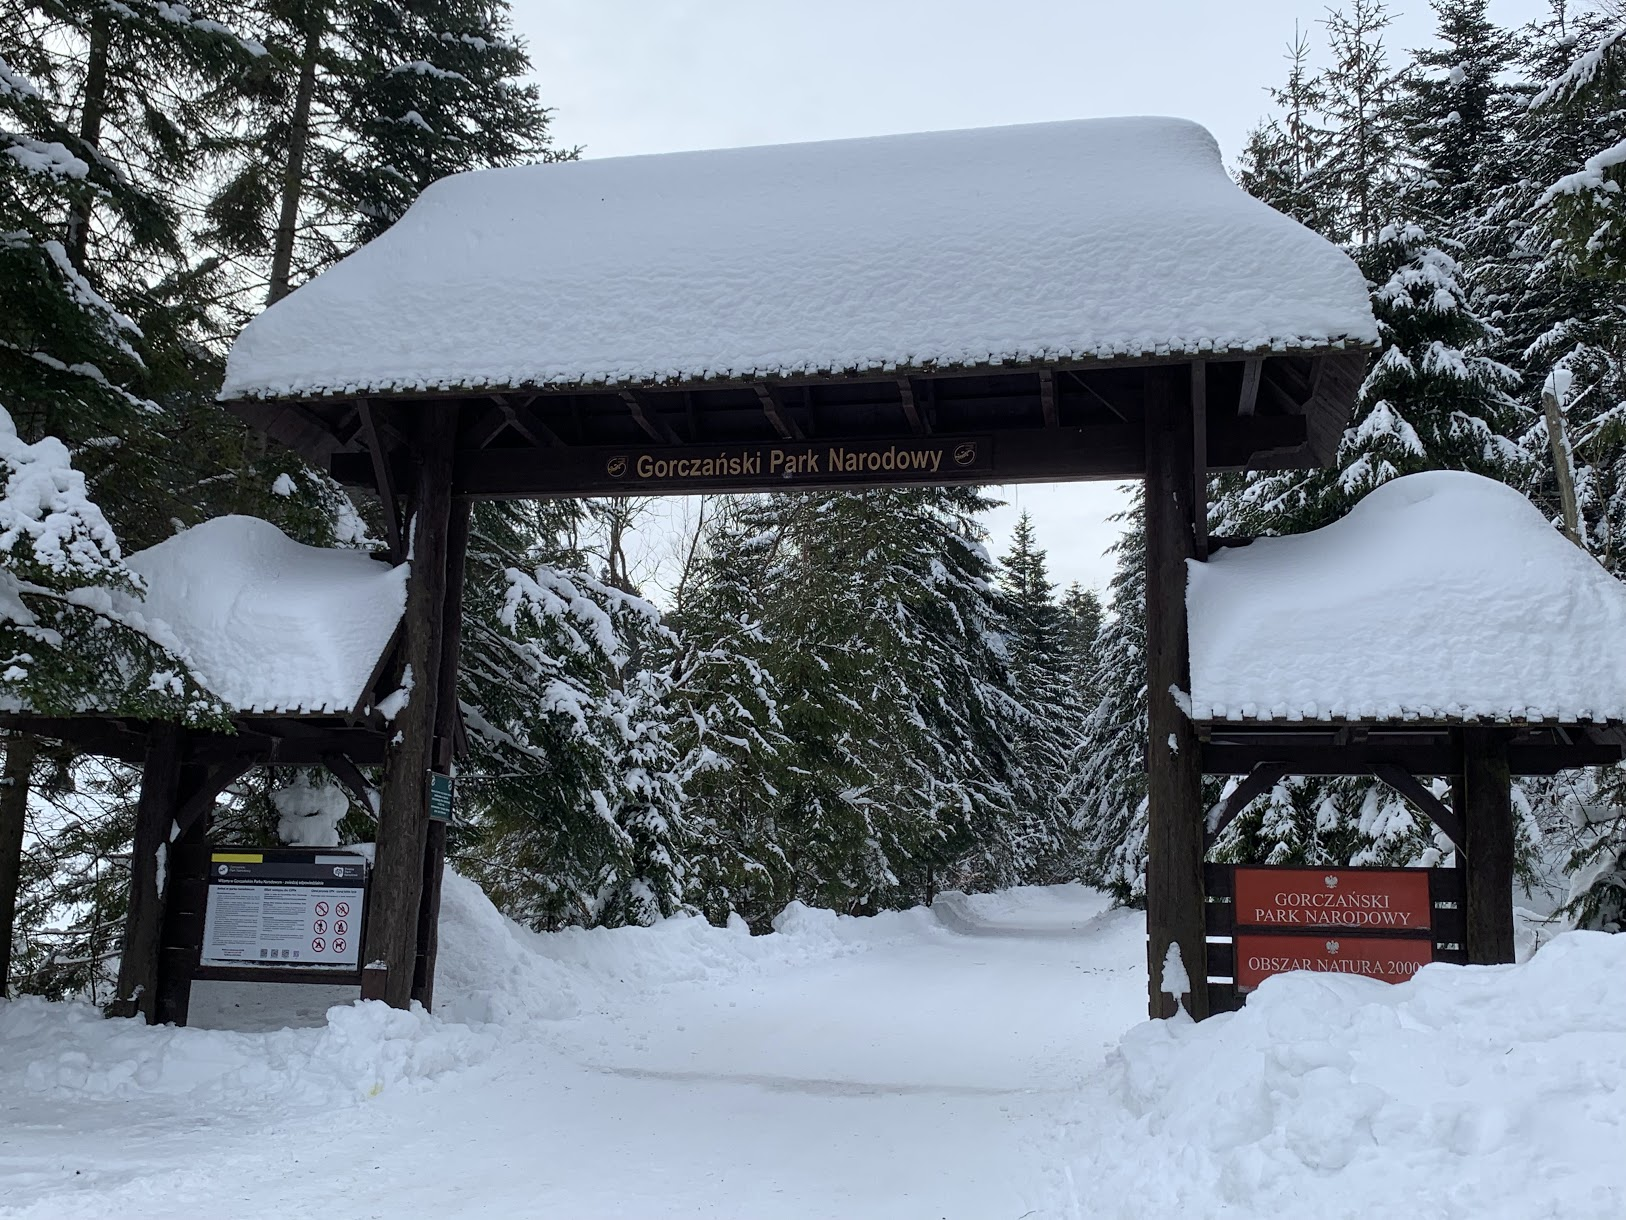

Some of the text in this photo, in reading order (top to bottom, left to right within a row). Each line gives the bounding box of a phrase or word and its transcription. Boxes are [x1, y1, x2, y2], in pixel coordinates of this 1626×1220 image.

[636, 445, 943, 478] Gorczański Park Narodowy
[1274, 891, 1389, 908] GORCZAŃSKI
[1255, 908, 1411, 925] PARK NARODOWY
[1248, 957, 1420, 975] OBSZAR NATURA 2000
